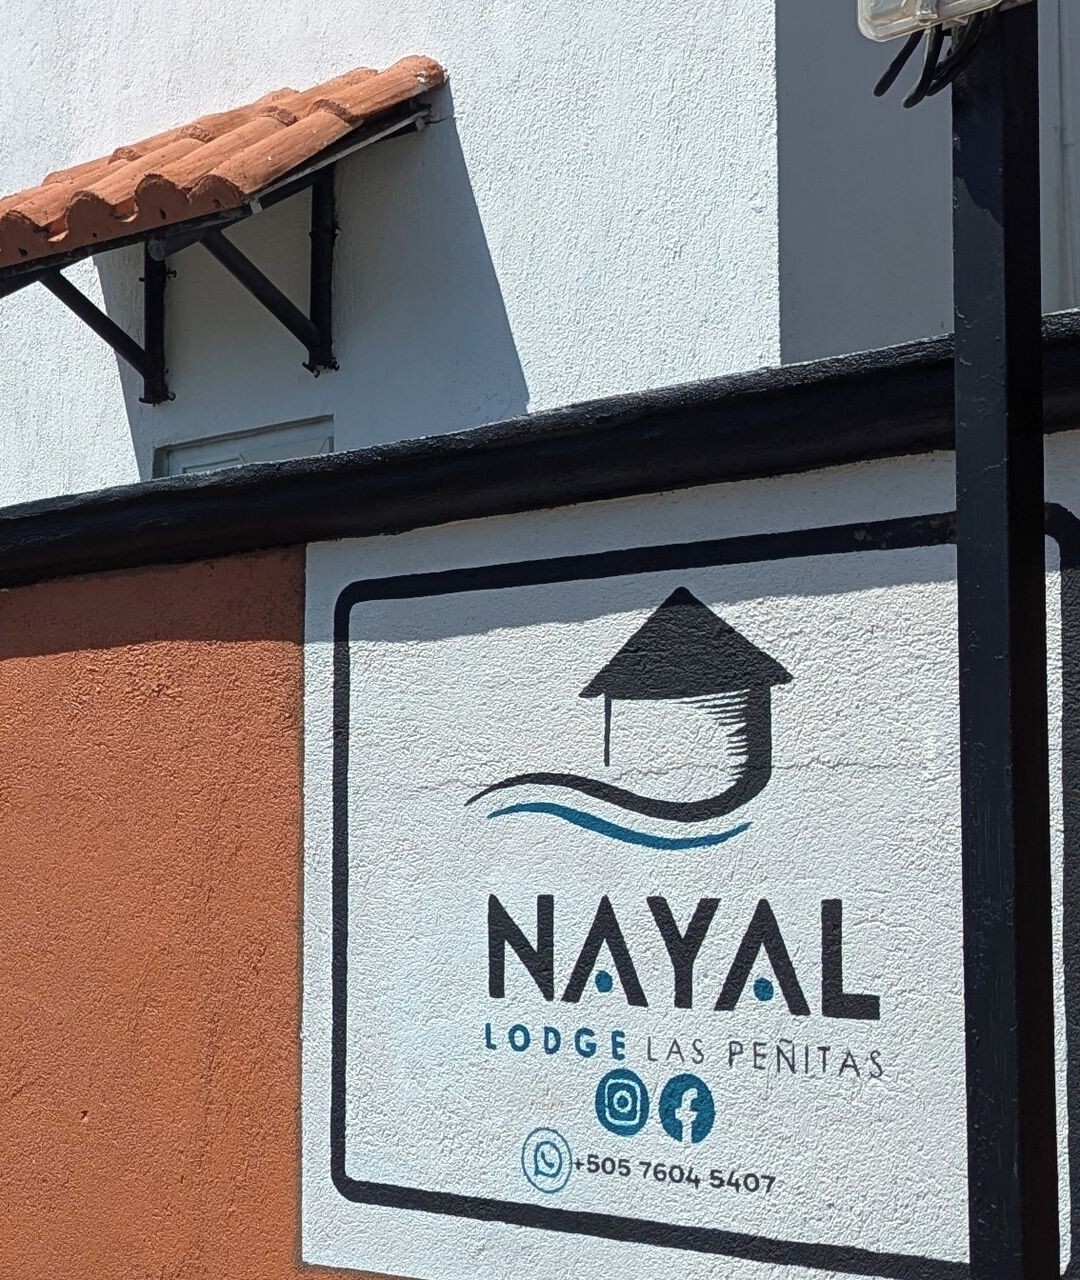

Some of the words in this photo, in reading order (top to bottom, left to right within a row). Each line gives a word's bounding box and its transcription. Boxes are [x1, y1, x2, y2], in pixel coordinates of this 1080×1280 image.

[487, 893, 881, 1021] NAYAL
[485, 1022, 626, 1061] LODGE
[647, 1036, 705, 1065] LAS
[728, 1038, 884, 1078] PEÑITAS
[574, 1153, 632, 1178] +505
[639, 1160, 701, 1190] 7604
[709, 1168, 777, 1195] 5407
